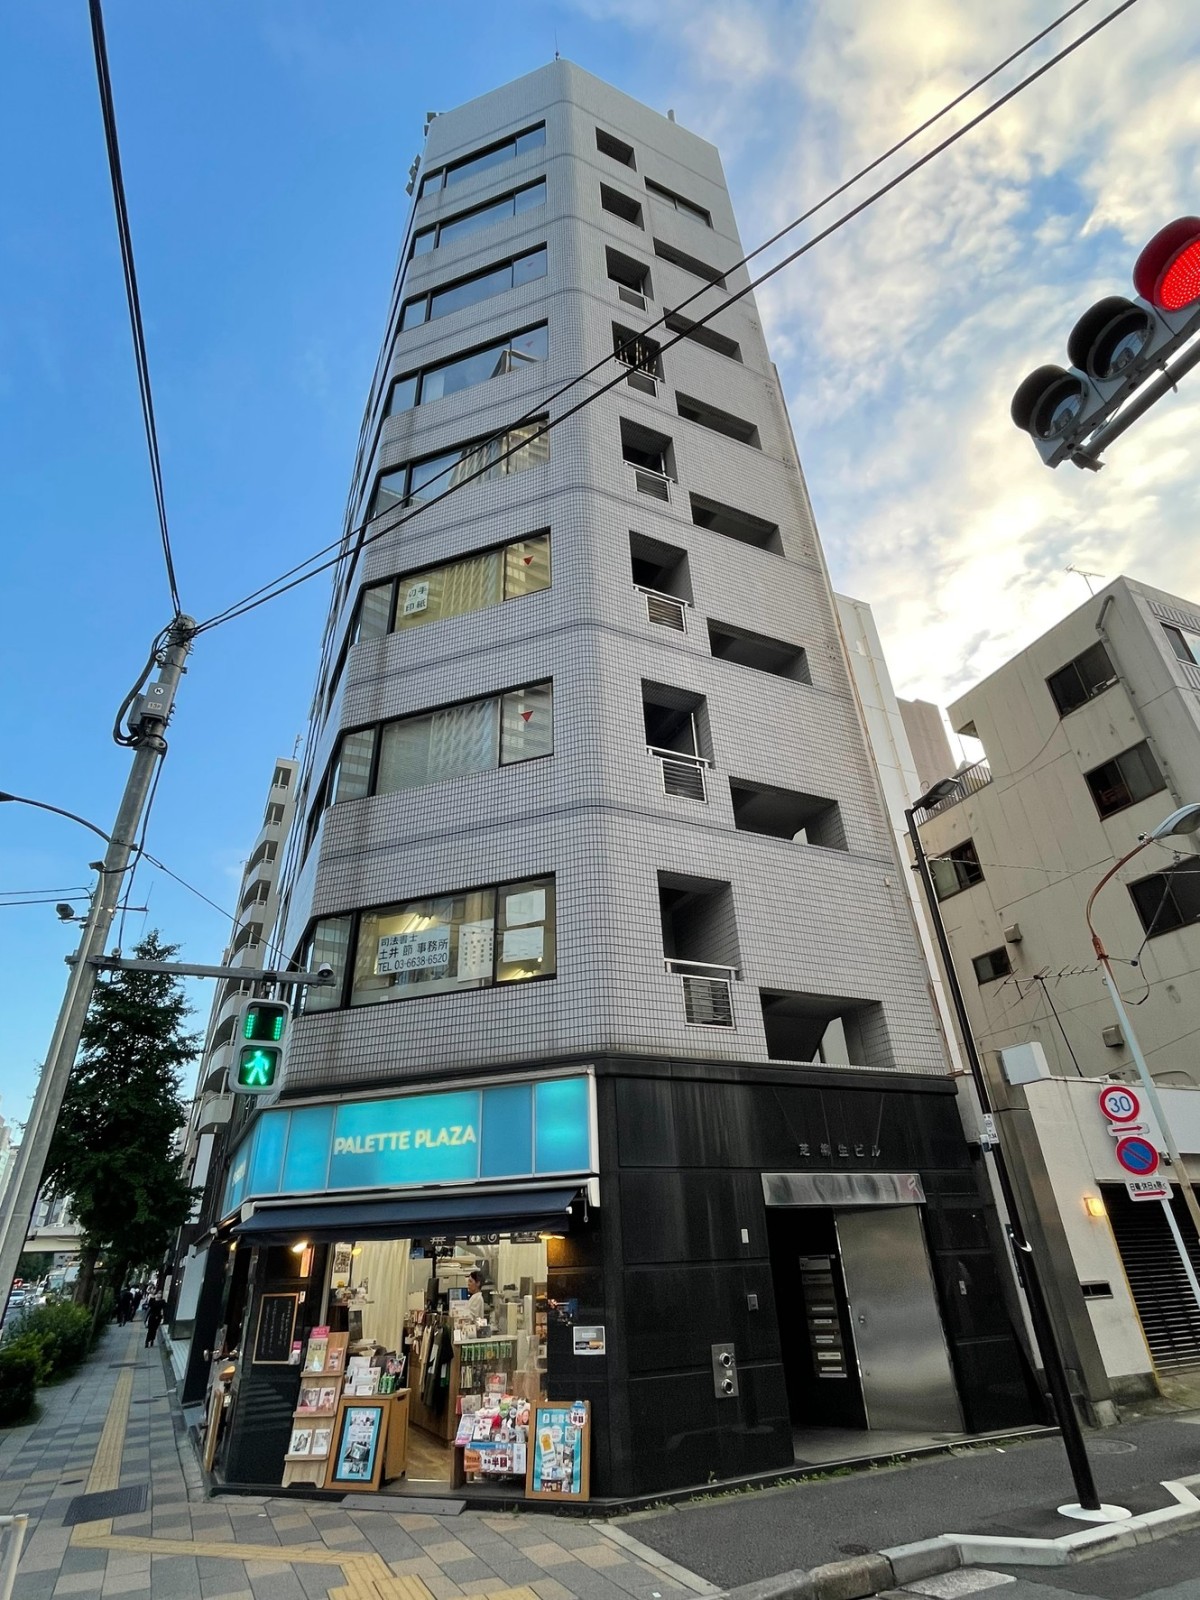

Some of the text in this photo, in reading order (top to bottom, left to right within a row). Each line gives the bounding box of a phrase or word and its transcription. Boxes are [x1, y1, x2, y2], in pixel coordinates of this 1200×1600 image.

[381, 934, 417, 947] 司法書士
[417, 938, 448, 954] 事務所
[378, 952, 447, 972] TEL 03-6638-6520
[1108, 1096, 1132, 1113] 30
[333, 1124, 477, 1155] PALETTE PLAZA
